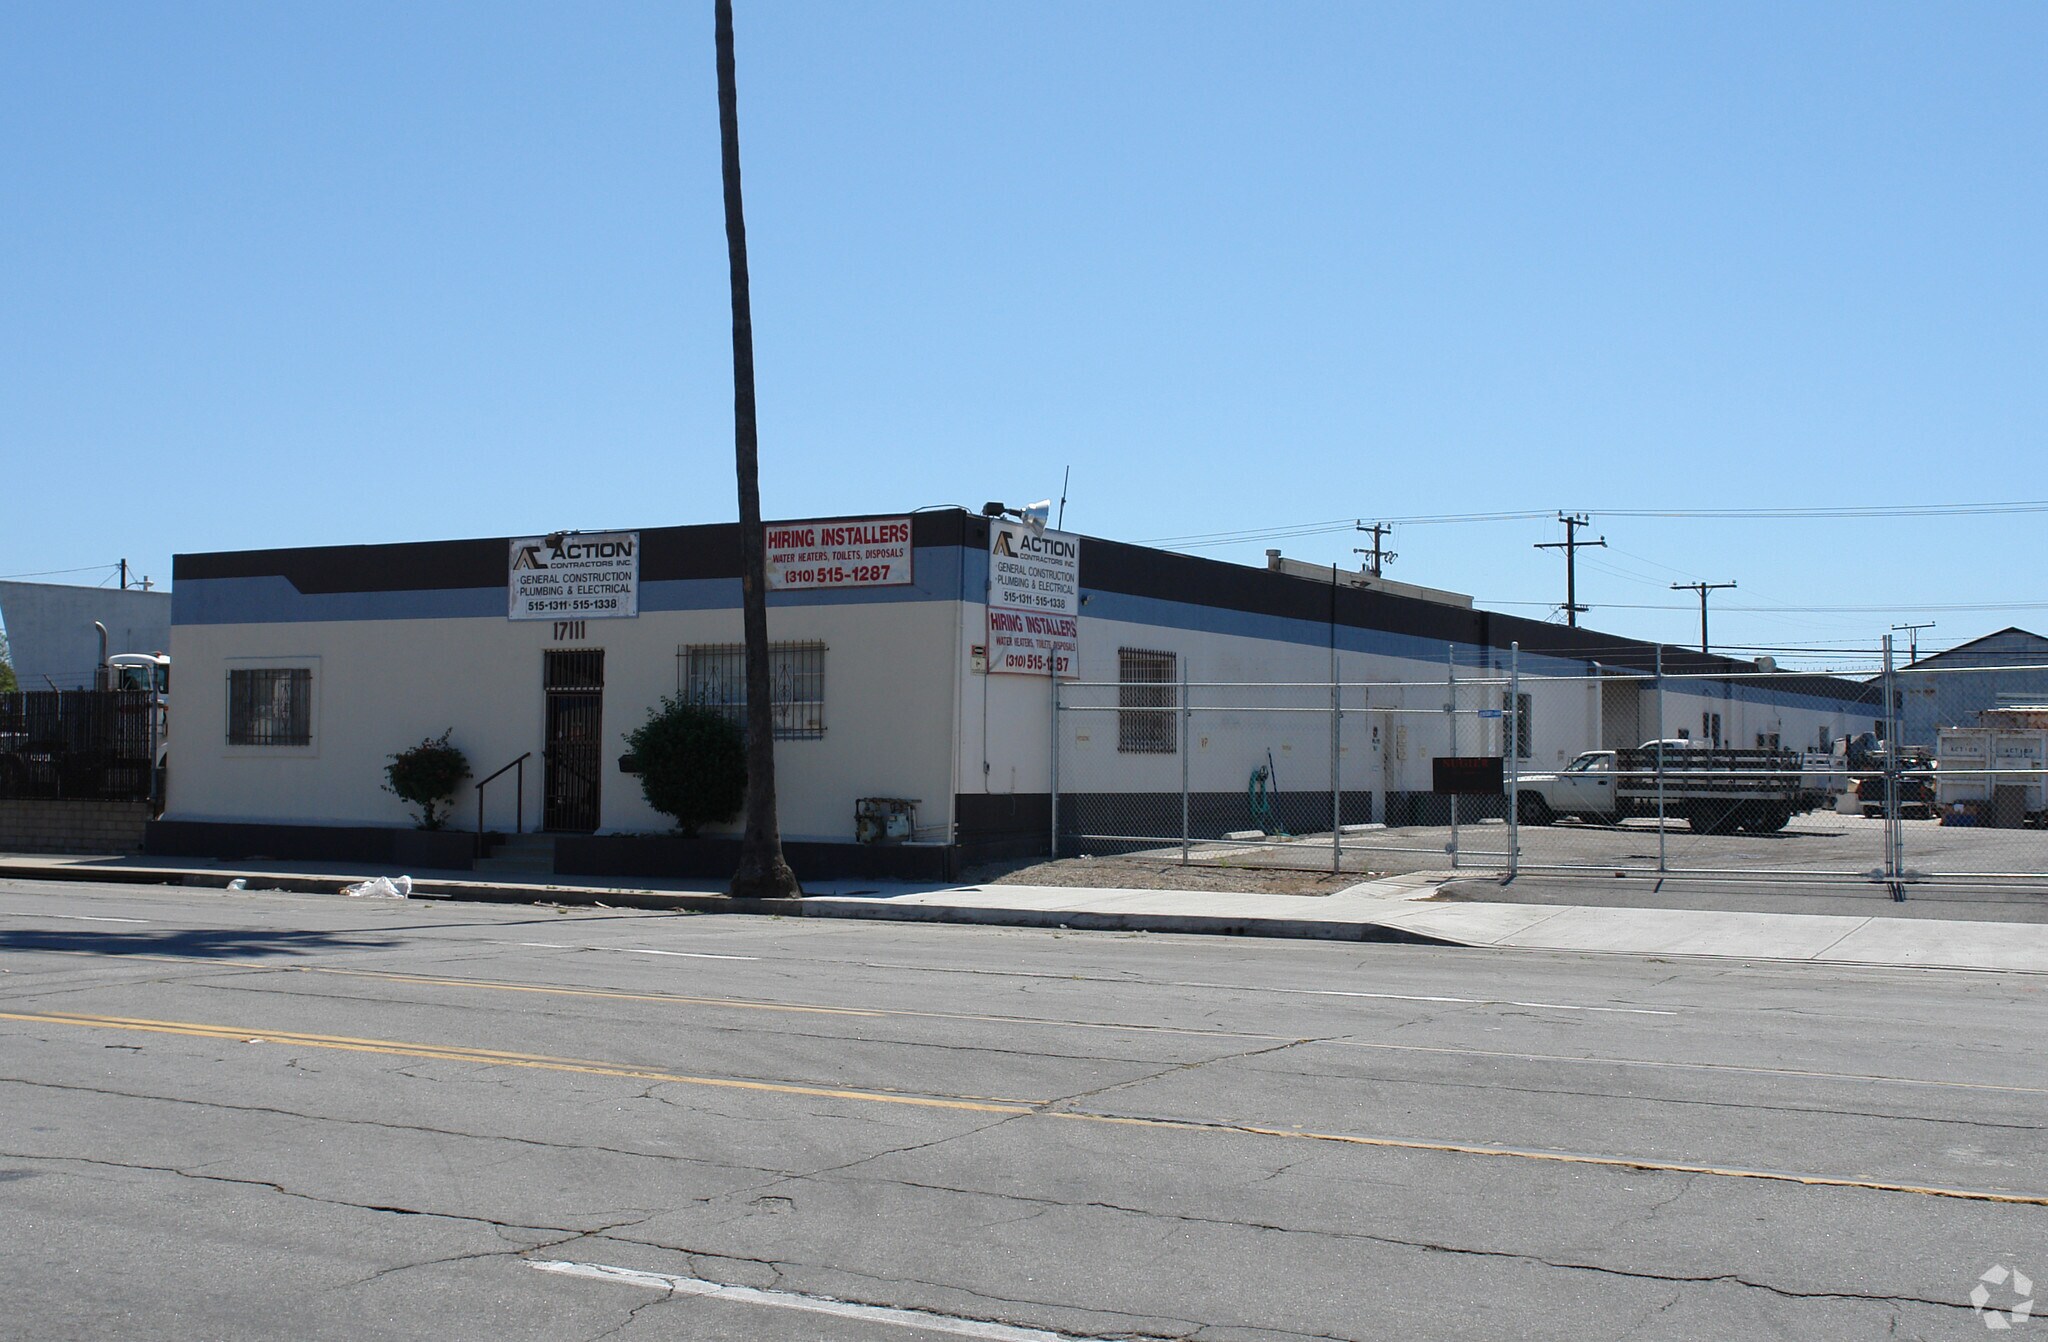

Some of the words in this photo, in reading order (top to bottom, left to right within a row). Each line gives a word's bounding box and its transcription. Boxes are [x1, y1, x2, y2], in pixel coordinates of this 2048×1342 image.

[768, 529, 814, 549] HIRING
[821, 524, 908, 546] INSTALLERS
[551, 542, 632, 560] ACTION
[773, 553, 795, 563] WATER
[798, 552, 830, 562] HEATERS,
[832, 550, 862, 560] TOILETS,
[866, 548, 904, 558] DISPOSALS
[1020, 535, 1075, 558] ACTION
[550, 560, 613, 569] CONTRACTORS
[1020, 553, 1063, 566] CONTRACTORS
[520, 575, 559, 584] GENERAL
[563, 572, 631, 582] CONSTRUCTION
[785, 570, 814, 583] (310)
[817, 565, 890, 583] 515-1287
[998, 562, 1026, 575] GENERAL
[1028, 566, 1074, 583] CONSTRUCTION
[520, 586, 563, 596] PLUMBING
[567, 586, 573, 594] &
[578, 584, 631, 594] ELECTRICAL
[998, 575, 1029, 588] PLUMBING
[1039, 580, 1074, 595] ELECTRICAL
[554, 621, 585, 640] 17111
[991, 613, 1023, 632] HIRING
[1025, 616, 1077, 638] INSTALLERS
[1006, 654, 1026, 668] (310)
[1027, 655, 1069, 672] 515-187
